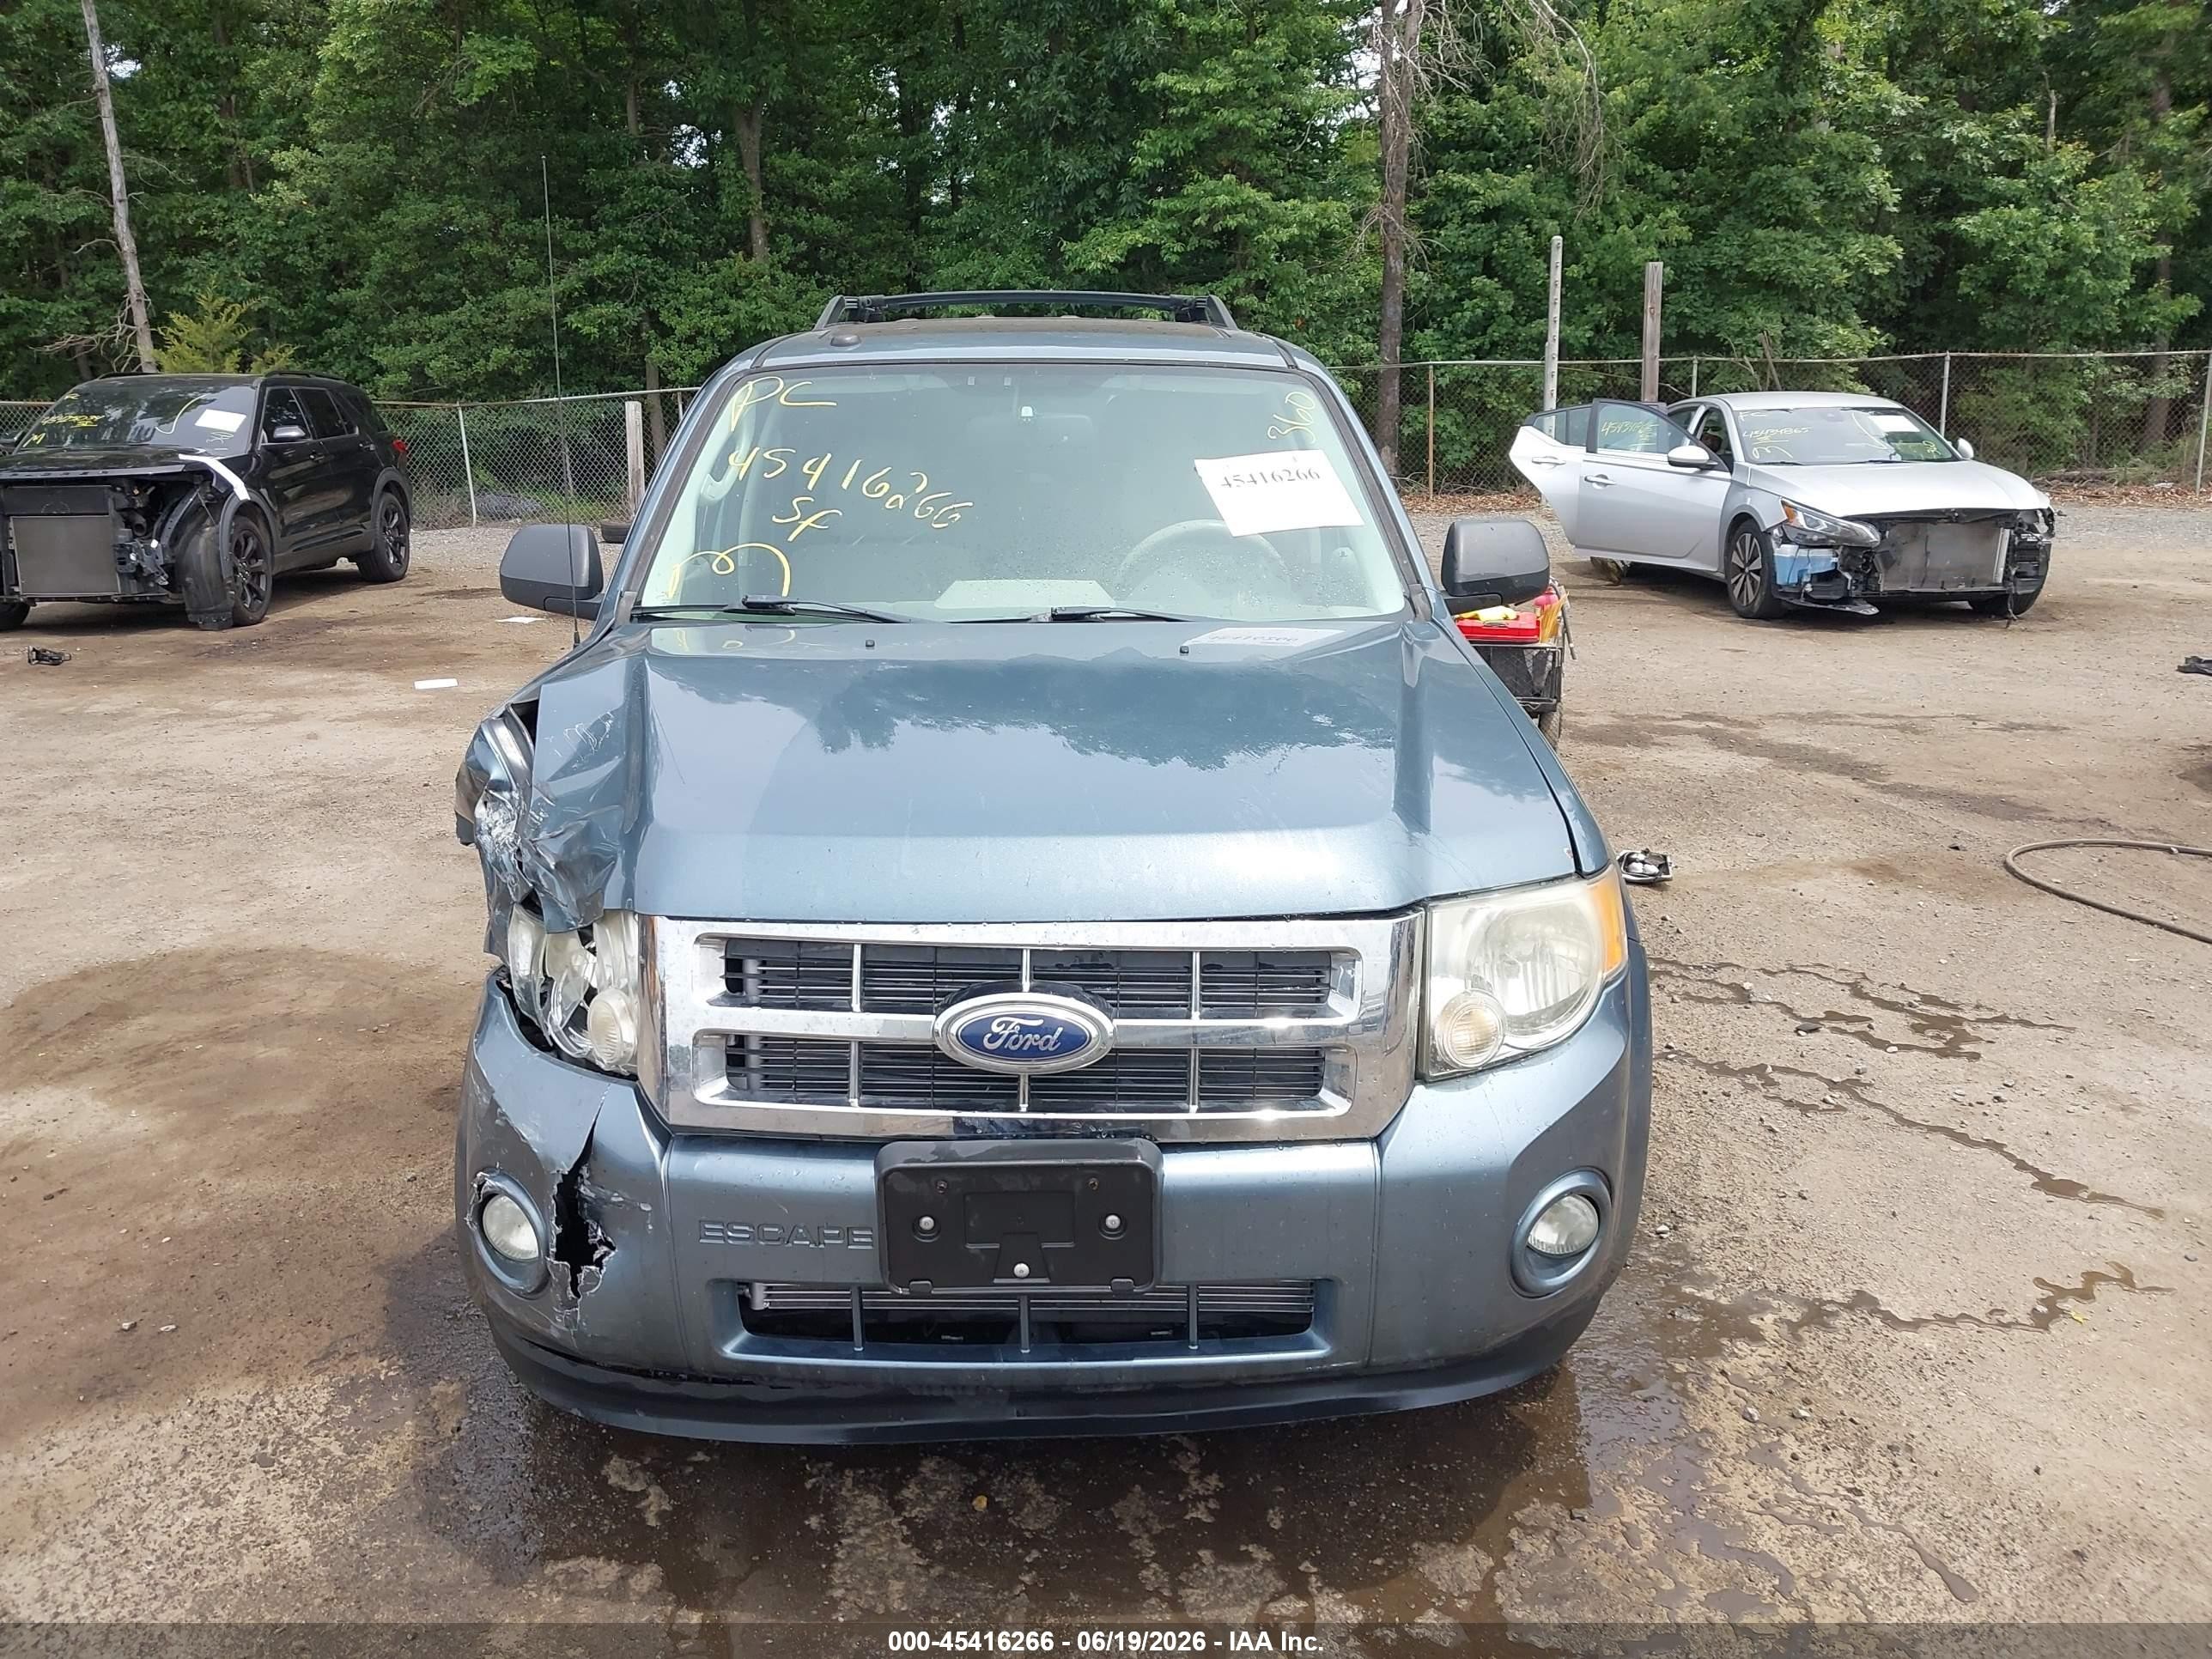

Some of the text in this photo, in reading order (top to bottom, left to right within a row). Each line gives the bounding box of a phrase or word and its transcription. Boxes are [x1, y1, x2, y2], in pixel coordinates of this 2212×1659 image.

[728, 447, 974, 529] 45416266
[1220, 467, 1322, 489] 45416266
[982, 1016, 1064, 1052] Ford
[699, 1220, 874, 1250] ESCAPE
